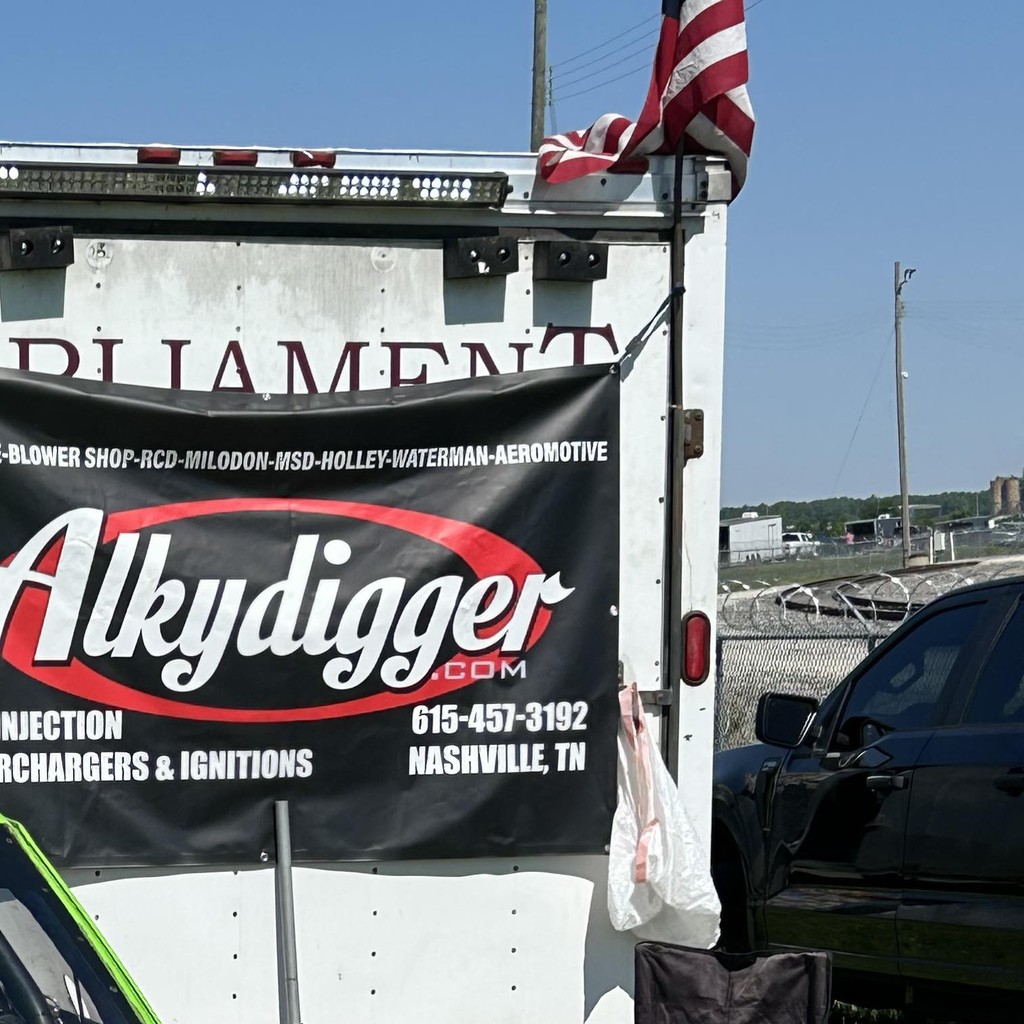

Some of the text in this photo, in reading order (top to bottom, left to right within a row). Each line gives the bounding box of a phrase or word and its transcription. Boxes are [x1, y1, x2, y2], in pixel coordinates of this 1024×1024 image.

[411, 701, 589, 735] 615-457-3192
[155, 755, 175, 781] &
[180, 748, 314, 781] IGNITIONS
[408, 741, 587, 776] NASHVILLE, TN
